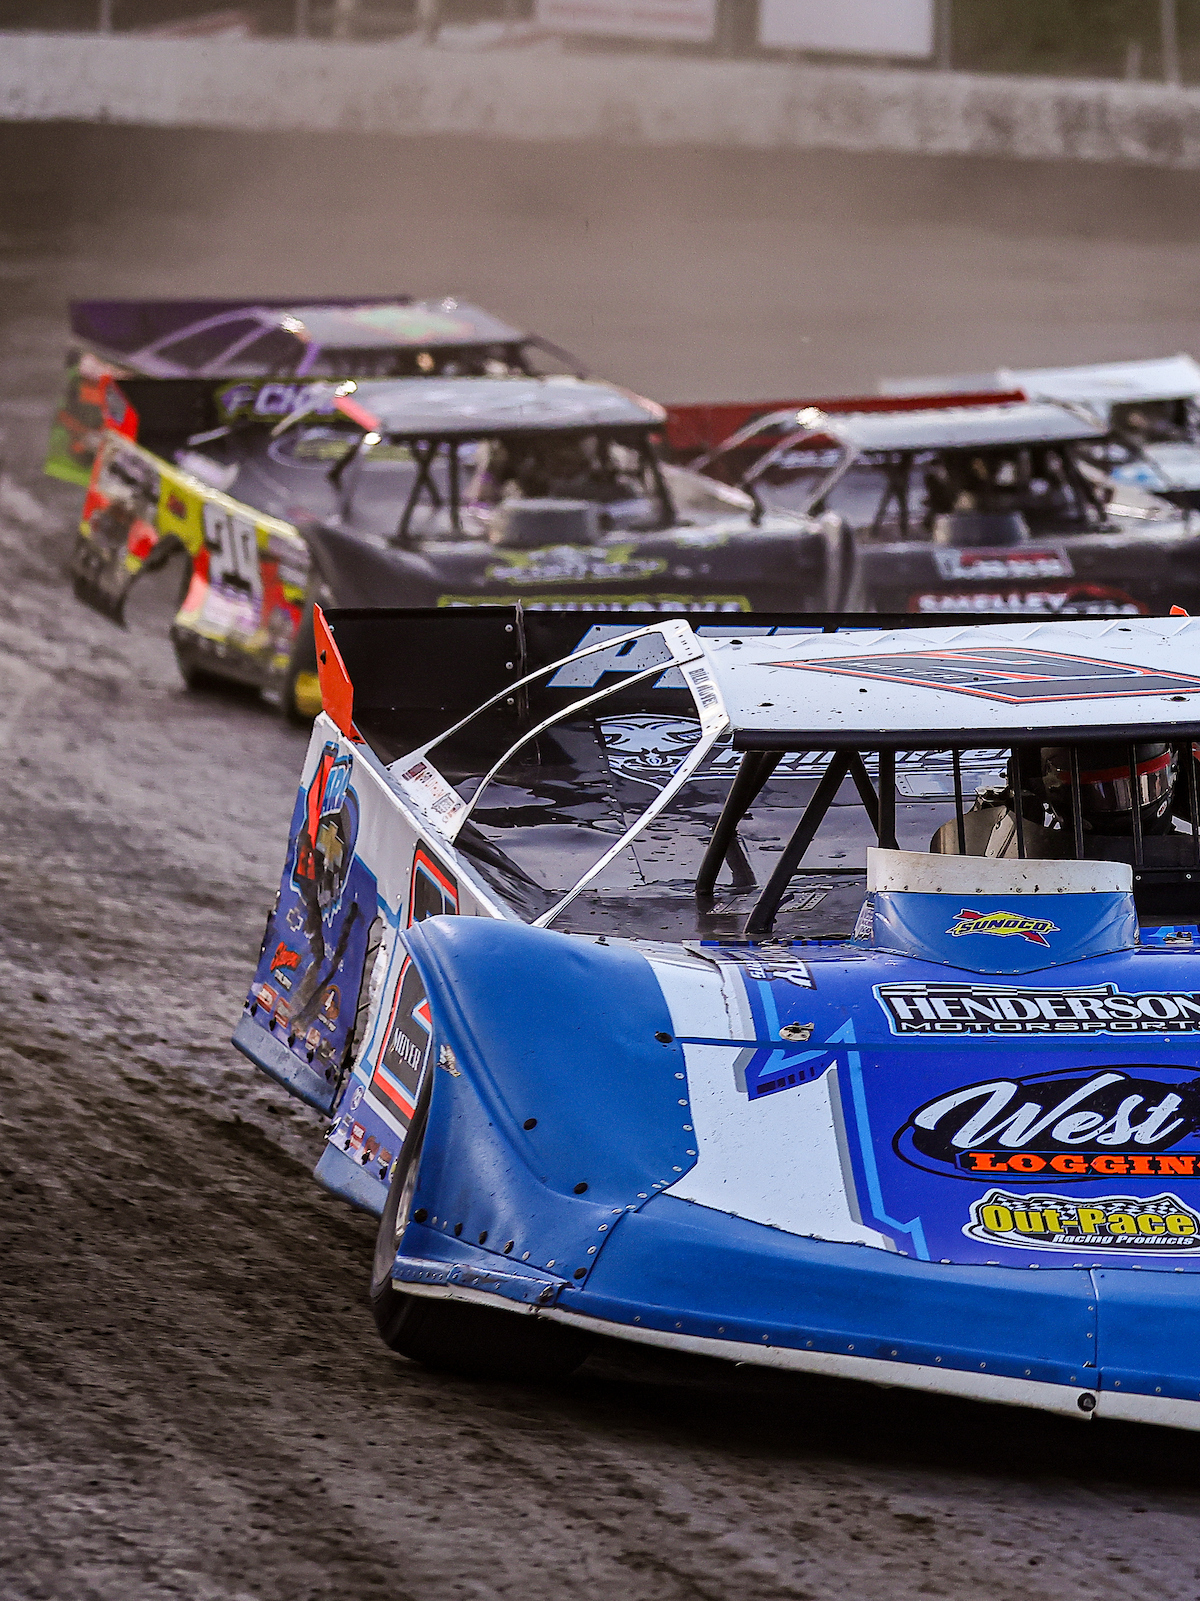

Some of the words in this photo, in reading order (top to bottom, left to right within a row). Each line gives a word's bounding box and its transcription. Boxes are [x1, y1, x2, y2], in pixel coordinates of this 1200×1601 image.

[959, 918, 1049, 932] SUNOCO
[393, 1027, 422, 1071] MOYER
[914, 1072, 1184, 1148] West
[981, 1203, 1196, 1236] Out-Pace
[1052, 1233, 1114, 1246] Racing
[1116, 1234, 1195, 1247] Products
